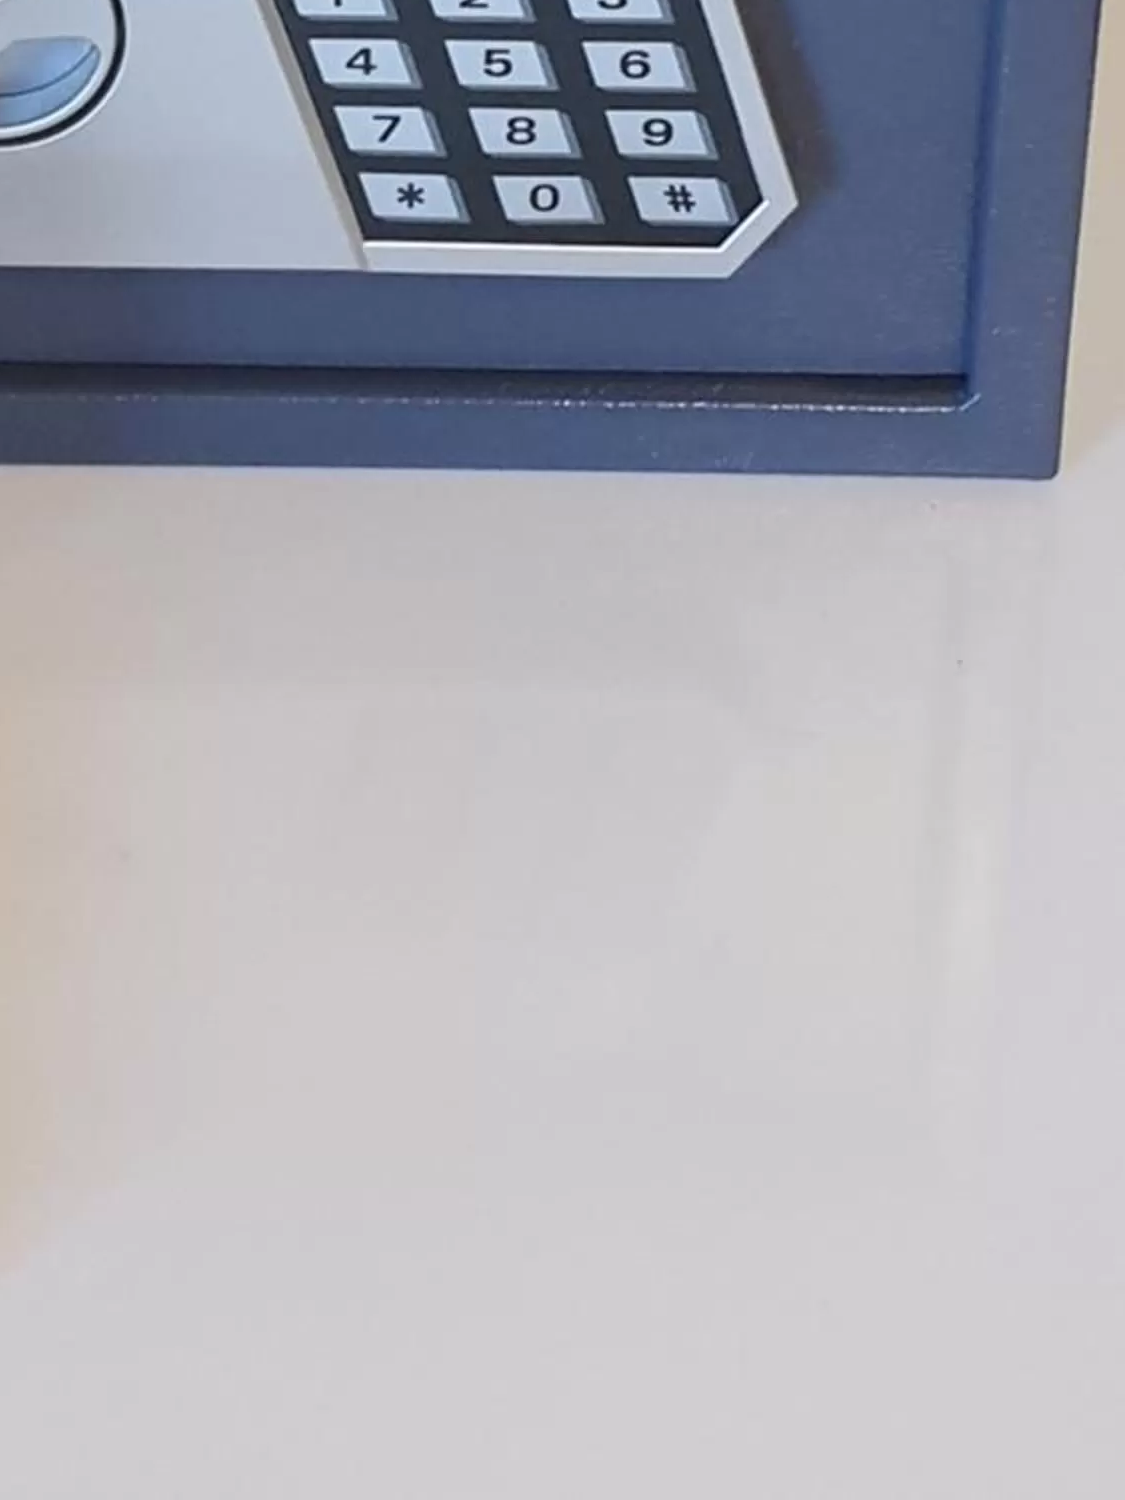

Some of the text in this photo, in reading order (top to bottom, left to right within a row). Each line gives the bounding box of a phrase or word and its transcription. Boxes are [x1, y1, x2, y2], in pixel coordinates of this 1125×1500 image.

[345, 48, 652, 79] 4 5 6
[371, 115, 674, 147] 7 8 9
[529, 184, 560, 213] 0
[662, 184, 698, 213] #
